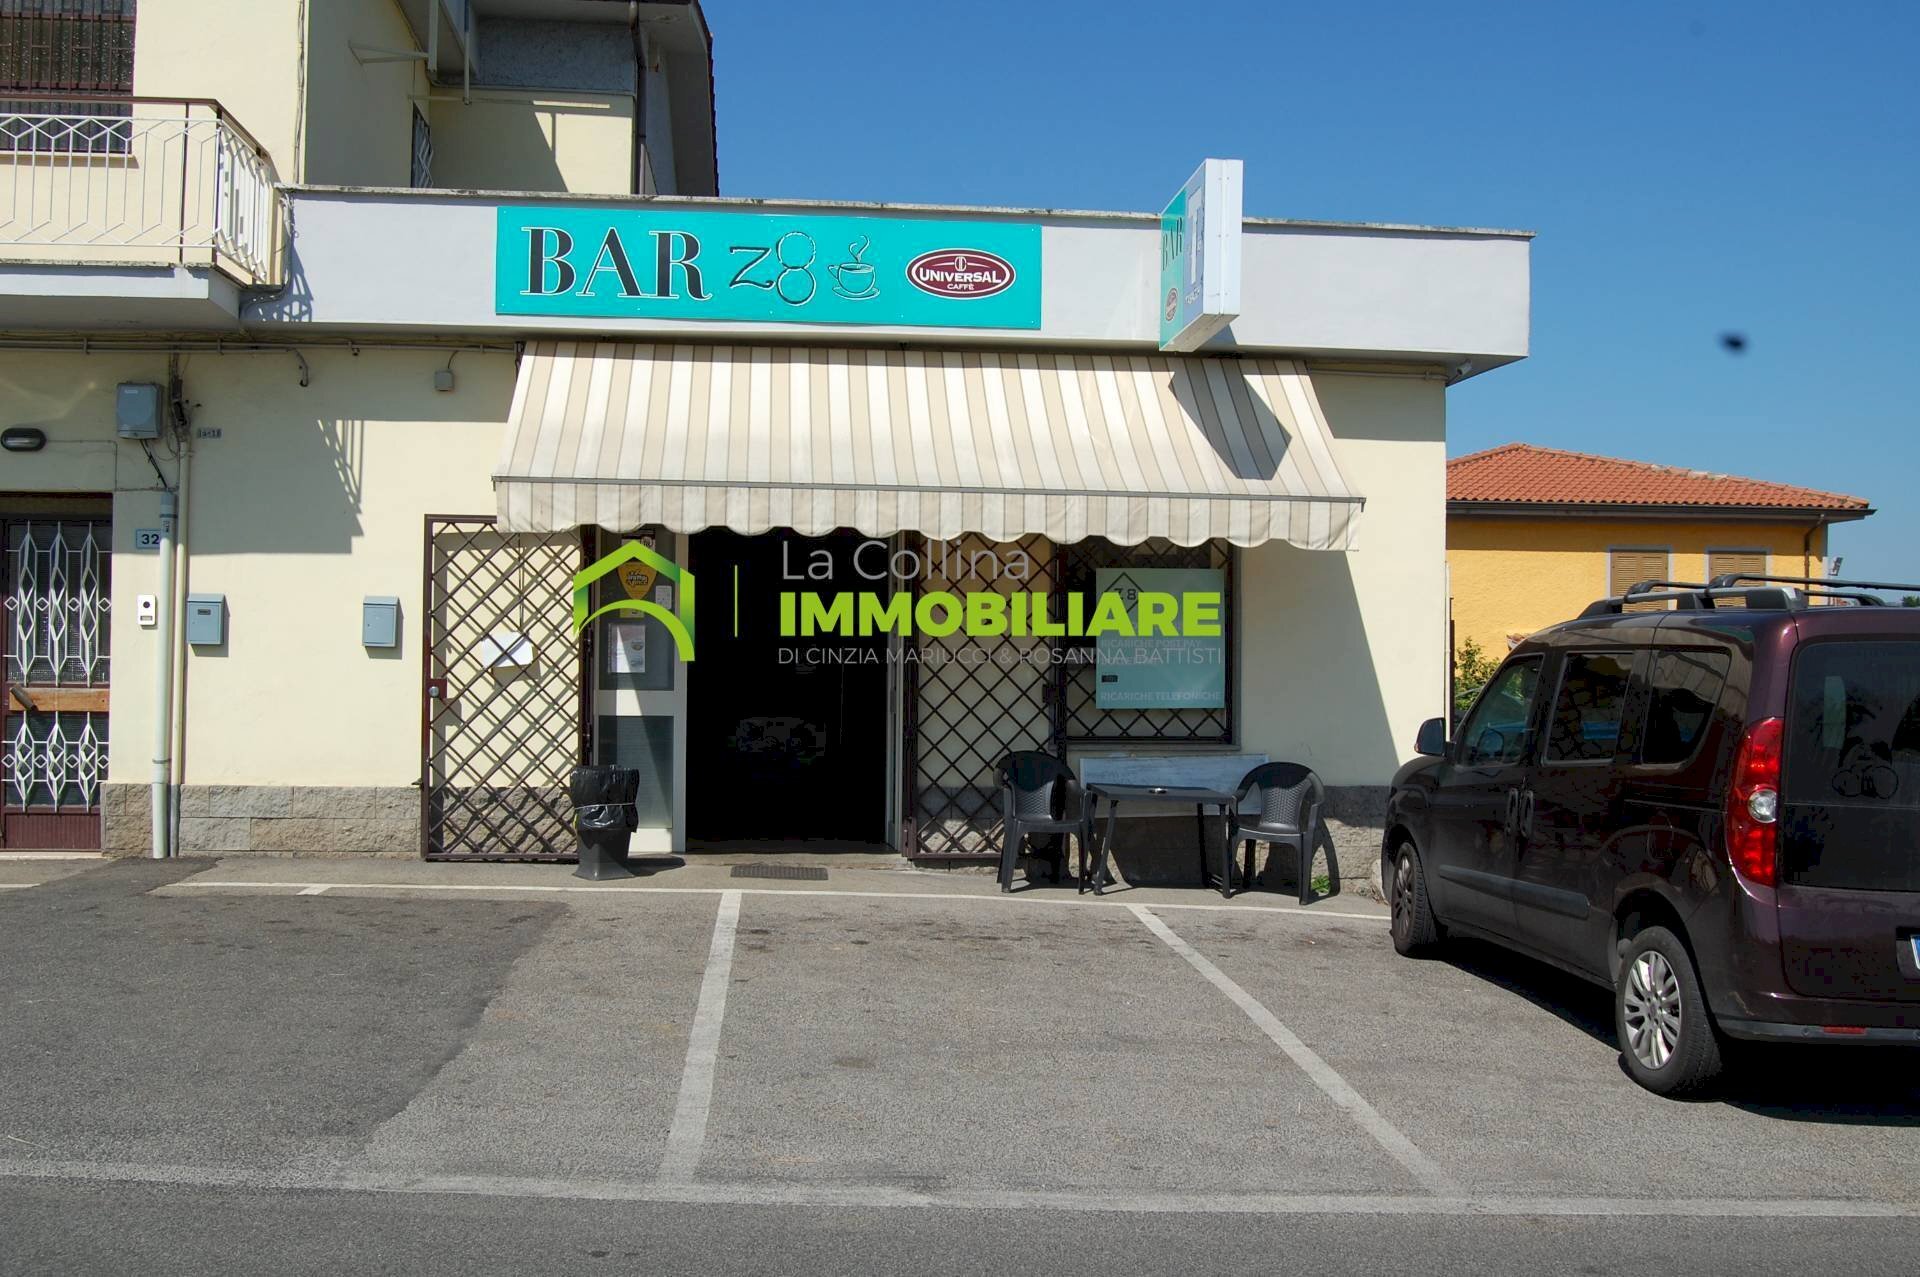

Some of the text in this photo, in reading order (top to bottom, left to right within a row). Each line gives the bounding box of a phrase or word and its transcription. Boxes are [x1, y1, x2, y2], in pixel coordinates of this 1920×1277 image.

[1162, 217, 1183, 271] BAR
[519, 226, 713, 301] BAR
[919, 267, 1002, 283] UNIVERSAL
[141, 533, 160, 545] 32
